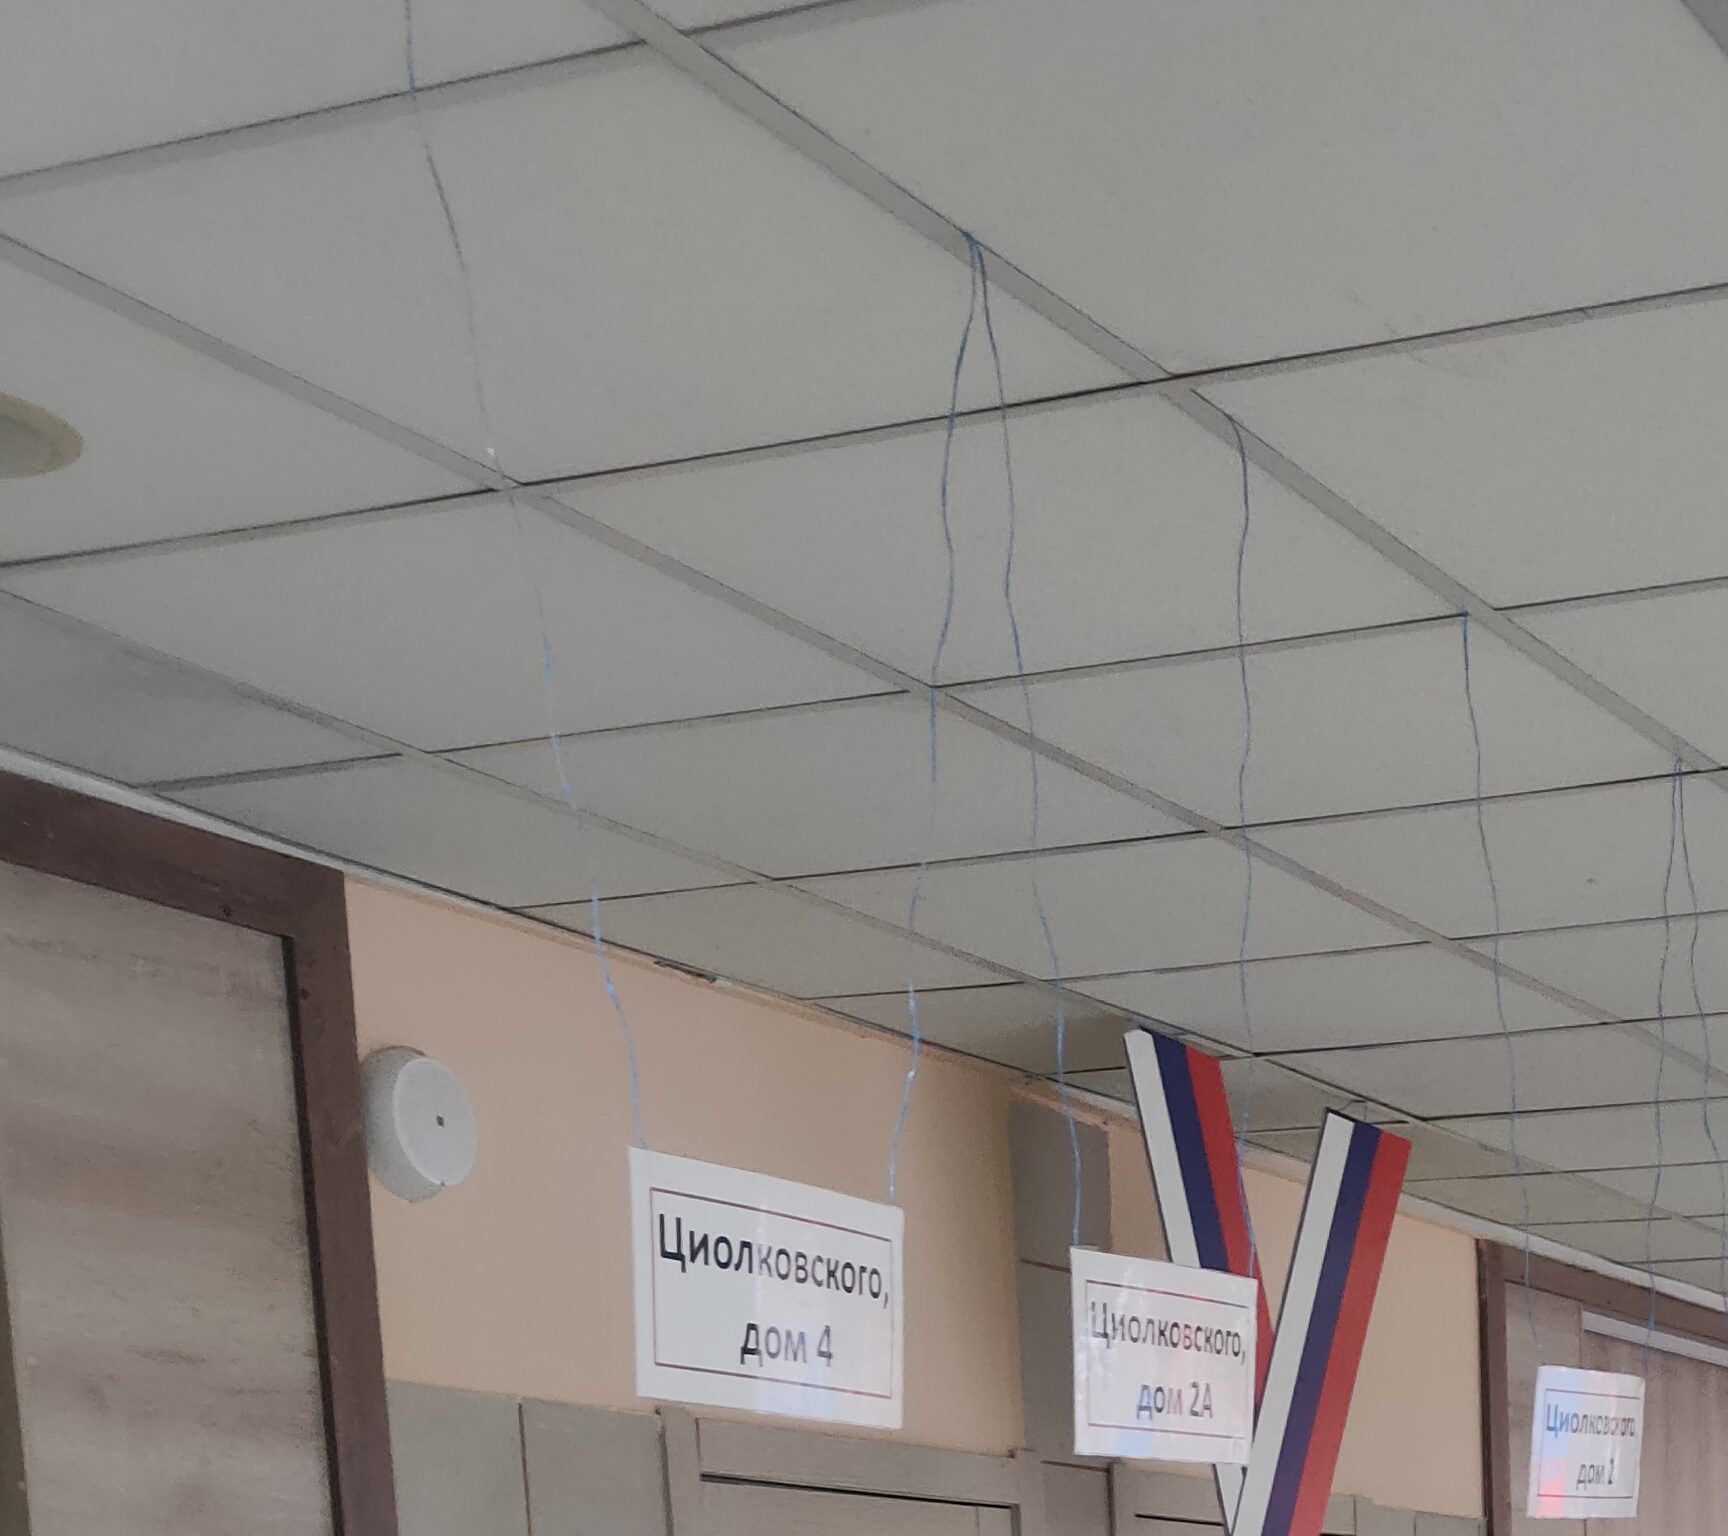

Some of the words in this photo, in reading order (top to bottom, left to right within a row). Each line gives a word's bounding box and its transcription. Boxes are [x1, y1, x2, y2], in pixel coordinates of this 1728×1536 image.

[658, 1213, 889, 1309] Циолковского,
[739, 1322, 807, 1367] дом
[817, 1325, 833, 1367] 4
[1091, 1301, 1246, 1364] Циолковского,
[1136, 1384, 1183, 1421] дом
[1576, 1464, 1605, 1490] дом
